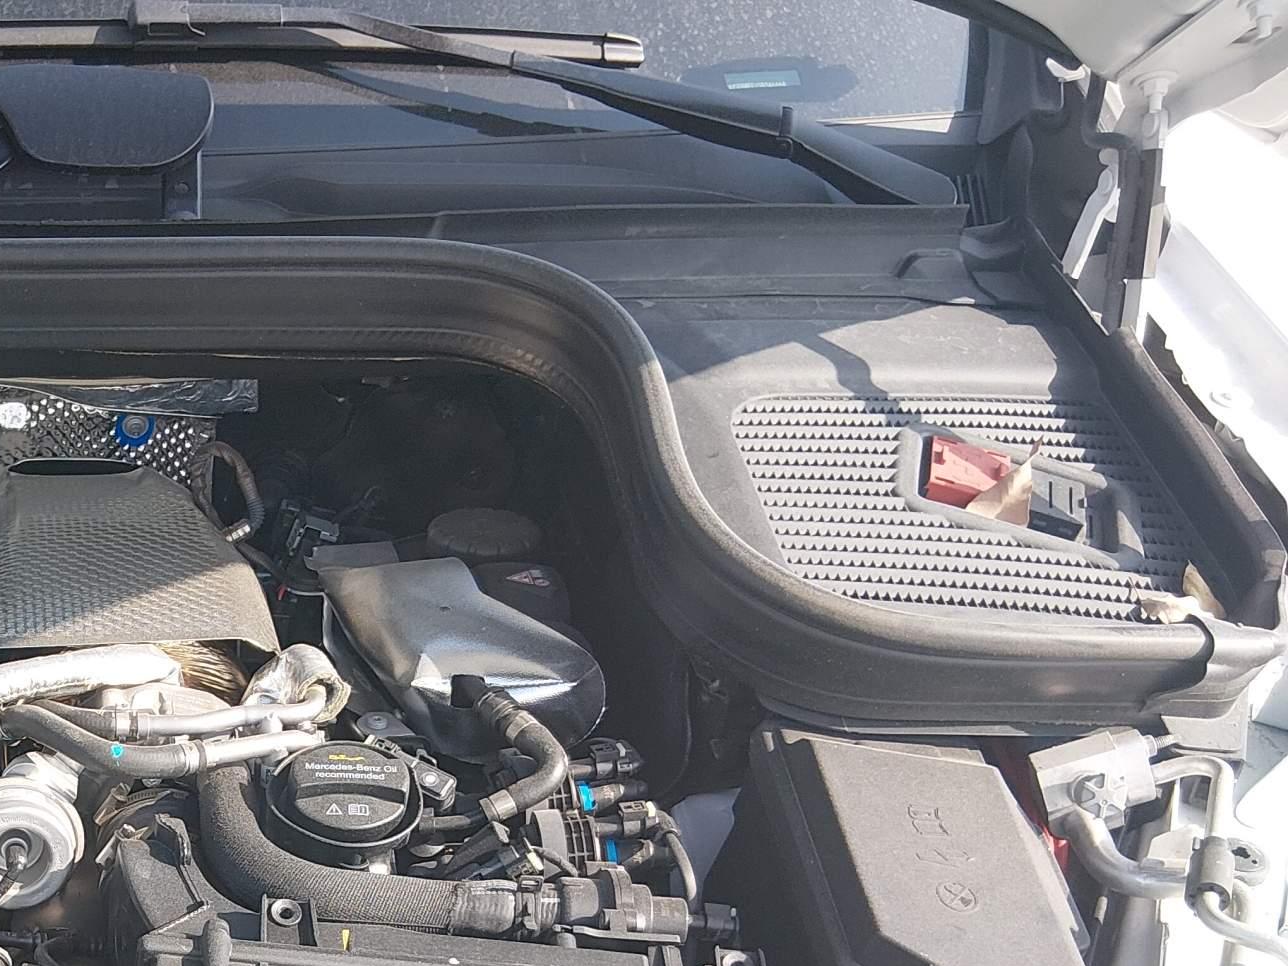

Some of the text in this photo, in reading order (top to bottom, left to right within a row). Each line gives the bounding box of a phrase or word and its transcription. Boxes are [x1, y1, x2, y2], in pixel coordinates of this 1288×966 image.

[305, 762, 398, 772] Mercedes-Benz Oil
[315, 771, 385, 780] recommended
